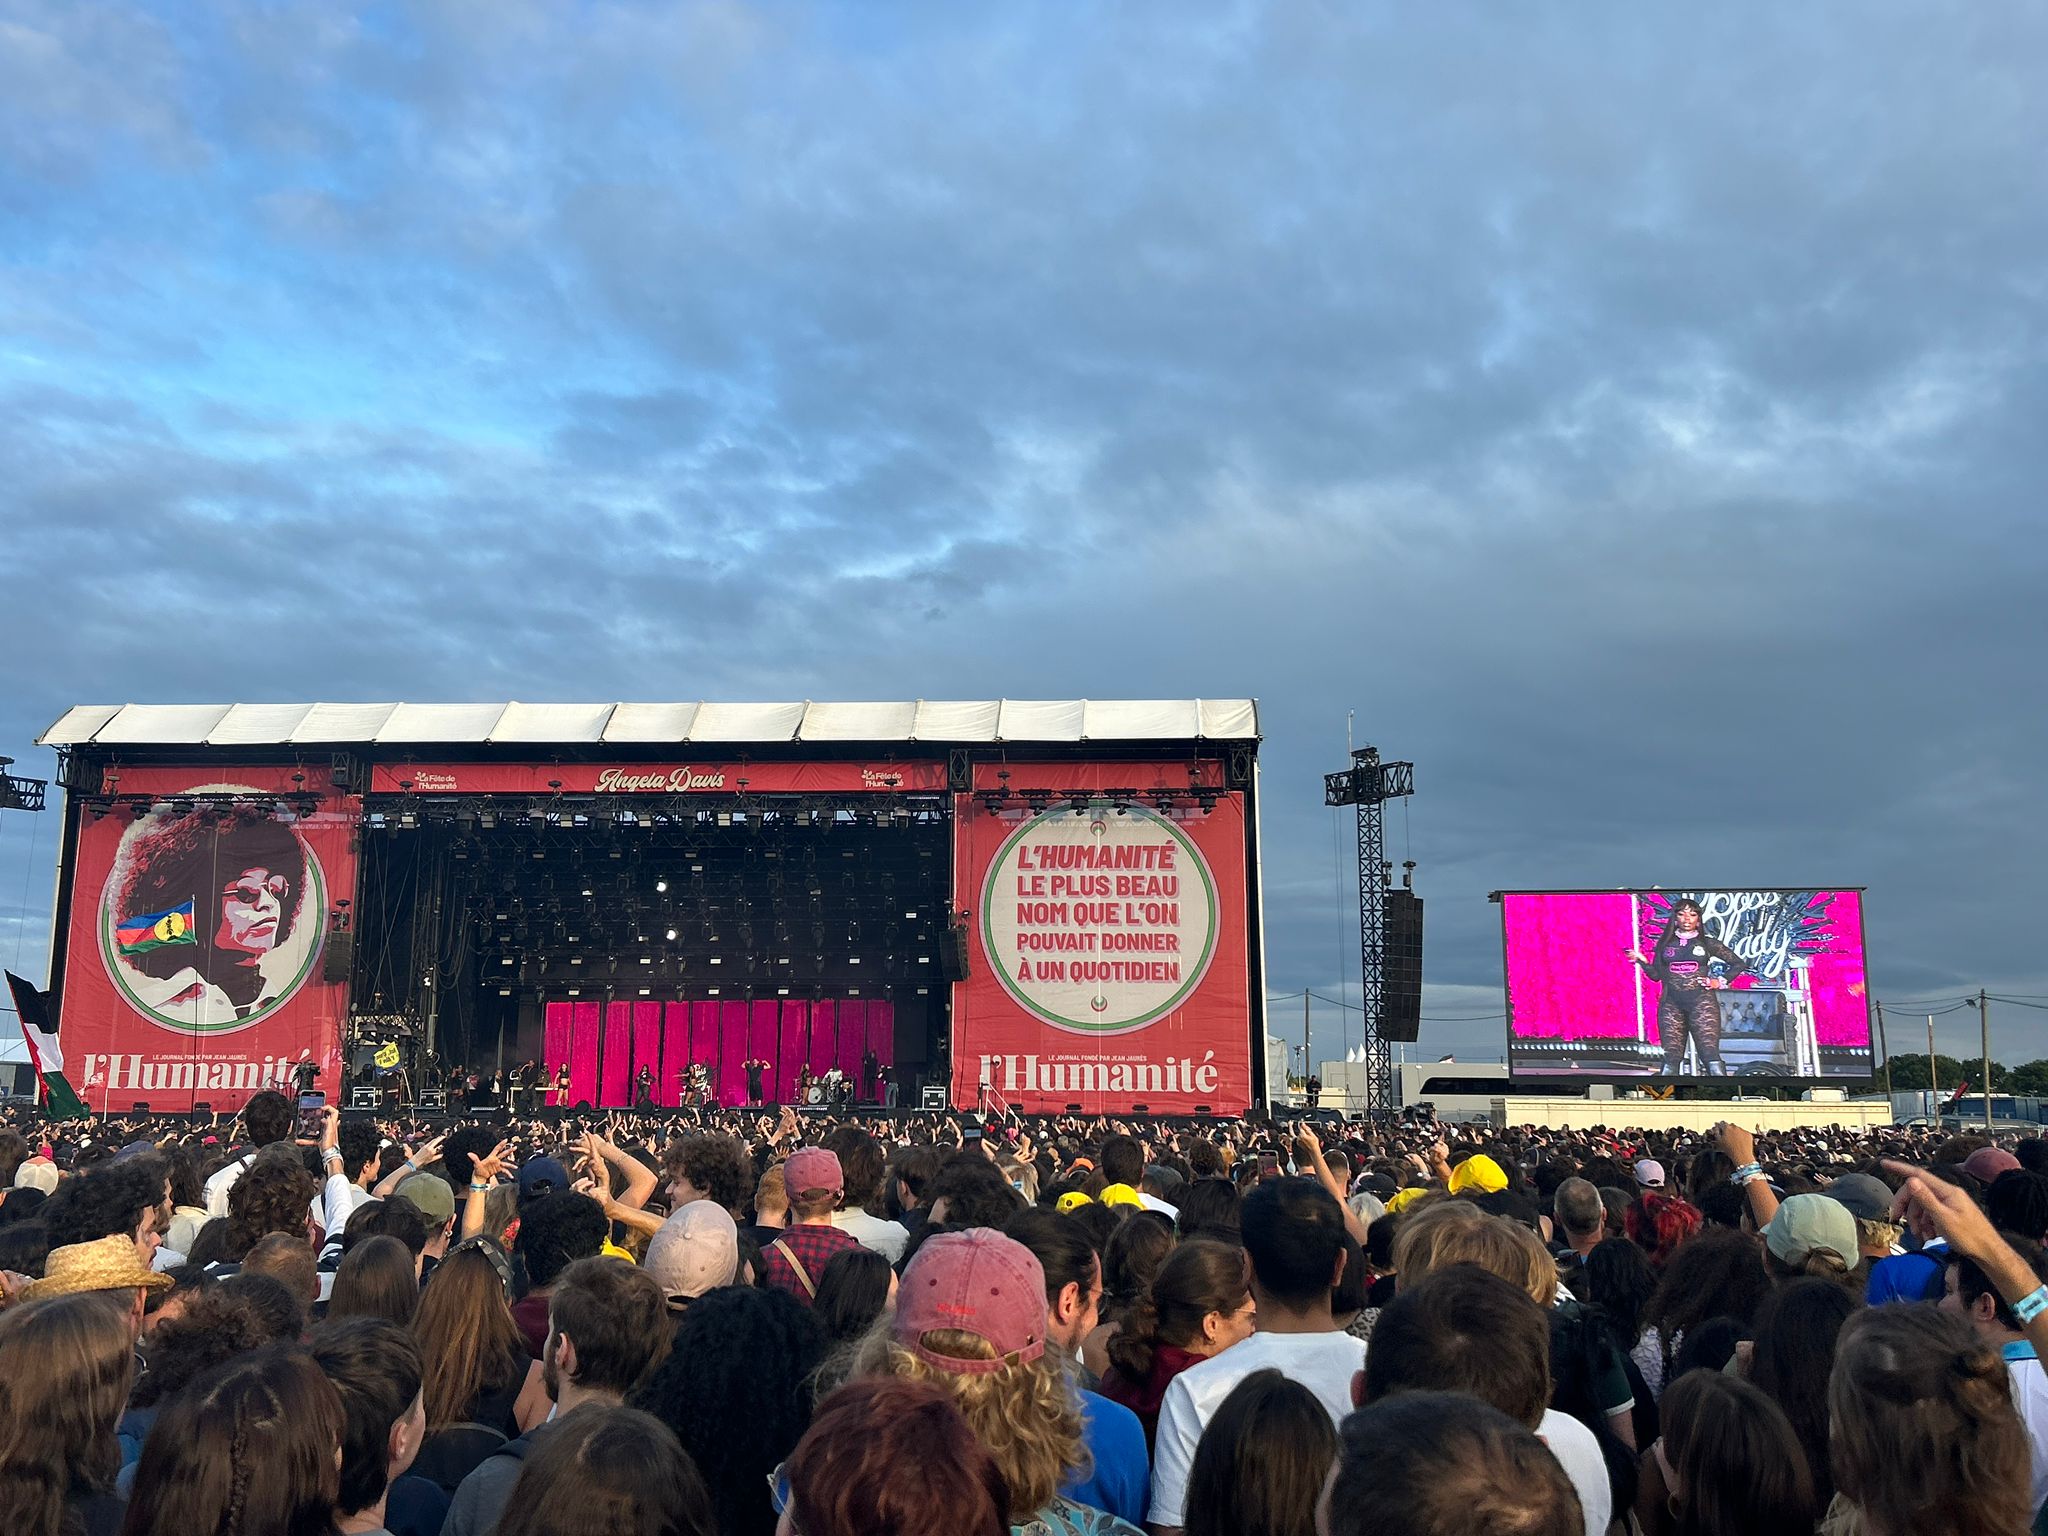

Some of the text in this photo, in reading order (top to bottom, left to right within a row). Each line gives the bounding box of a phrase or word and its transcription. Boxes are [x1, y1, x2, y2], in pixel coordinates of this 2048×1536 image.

[594, 766, 725, 792] Angela Davis
[1018, 840, 1177, 870] L'HUMANITÉ
[1017, 876, 1179, 897] LE PLUS BEAU
[1017, 902, 1179, 928] NOM QUE L'ON
[1017, 933, 1180, 952] POUVAIT DONNER
[1017, 957, 1180, 984] À UN QUOTIDIEN
[1100, 1054, 1110, 1062] PAR
[1111, 1054, 1125, 1062] JEAN
[979, 1050, 1218, 1093] l'Humanité
